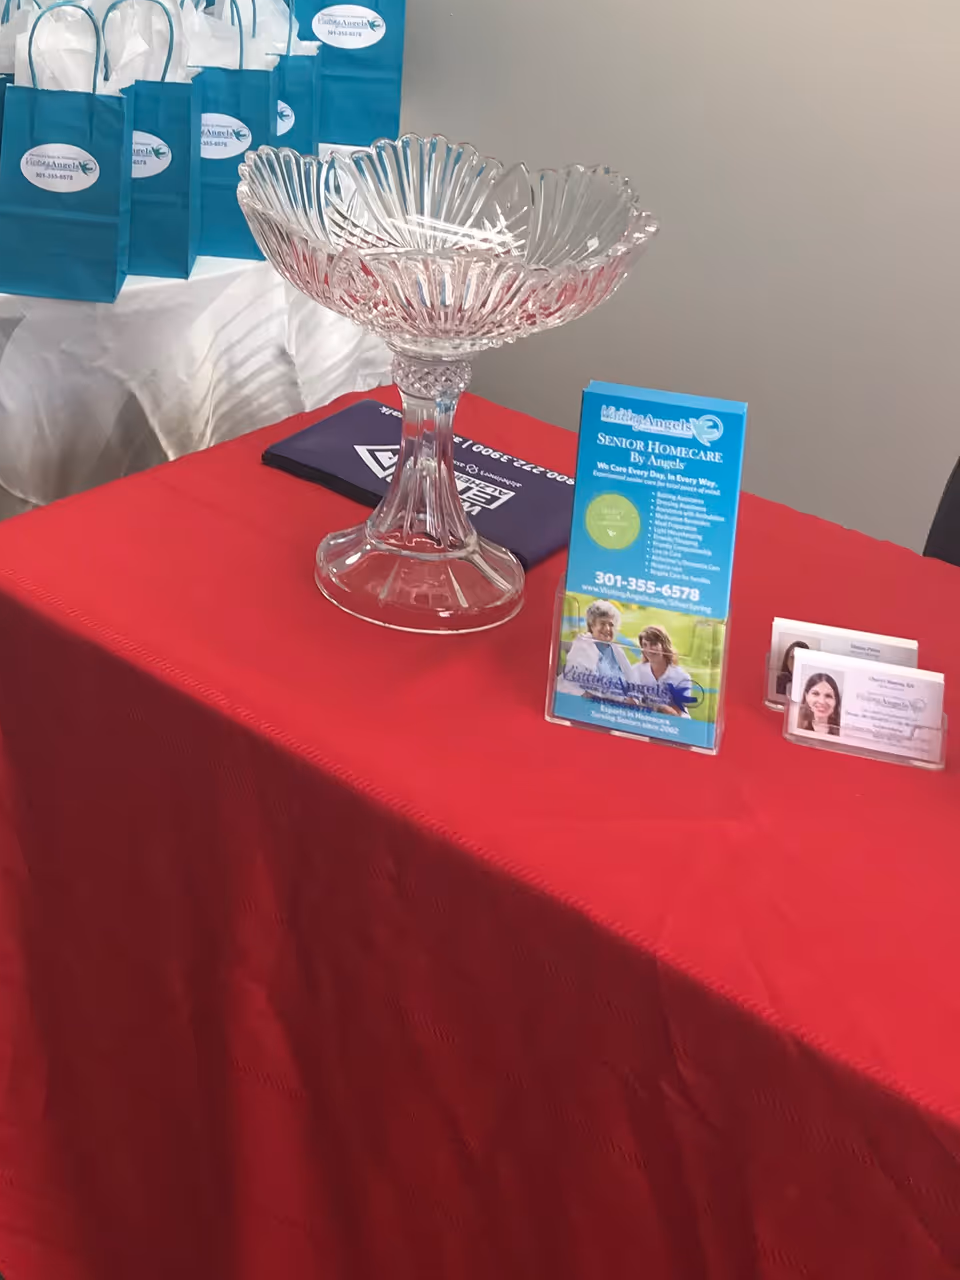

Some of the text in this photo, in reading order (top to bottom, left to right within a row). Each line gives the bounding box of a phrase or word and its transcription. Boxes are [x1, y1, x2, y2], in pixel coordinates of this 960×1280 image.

[206, 128, 234, 138] Angels
[51, 159, 80, 170] Angels
[601, 405, 642, 431] Visiting
[641, 414, 693, 432] Angels
[597, 433, 724, 463] SENIOR HOMECARE
[630, 452, 685, 470] By Angels
[597, 461, 719, 489] We Care Every Day, In Every Way.
[594, 571, 700, 601] 301-355-6578
[563, 665, 614, 694] Visiting
[614, 677, 670, 697] Angels
